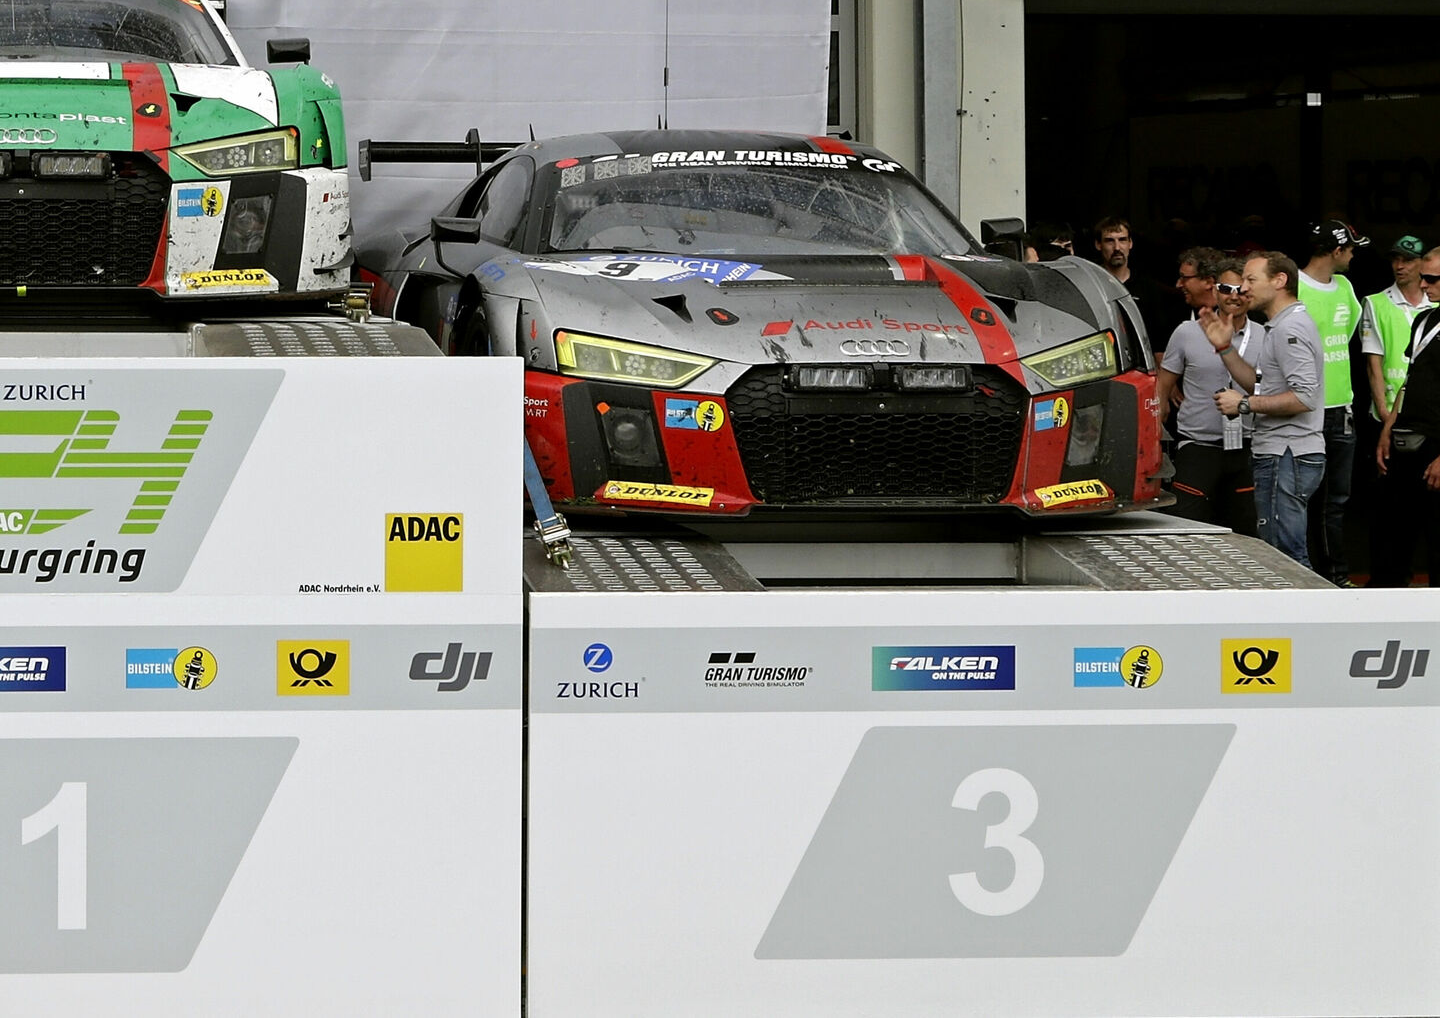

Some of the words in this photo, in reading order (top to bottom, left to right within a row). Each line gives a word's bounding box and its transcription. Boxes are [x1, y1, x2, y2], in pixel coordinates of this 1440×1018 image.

[651, 150, 726, 163] GRAN
[734, 150, 849, 165] TURISMO
[178, 198, 201, 207] BILSTEIN
[200, 273, 265, 283] DUNLOP
[803, 319, 874, 331] Audi
[882, 318, 969, 335] Sport
[1325, 334, 1348, 347] GRID
[1323, 349, 1350, 363] ARSH
[4, 384, 86, 401] ZURICH
[524, 396, 549, 407] Sport
[624, 486, 709, 500] DUNLOP
[1053, 484, 1103, 498] DUNLO
[388, 516, 461, 542] ADAC
[298, 584, 322, 593] ADAC
[323, 584, 364, 593] Nordrhein
[366, 584, 381, 593] e.V.
[127, 663, 172, 675] BILSTEIN
[890, 656, 999, 671] FALKEN
[1075, 662, 1119, 674] BILSTEIN
[16, 674, 46, 682] PULSE
[705, 667, 743, 681] GRAN
[746, 667, 808, 681] TURISMO
[932, 672, 946, 680] ON
[948, 672, 965, 680] THE
[967, 672, 996, 680] PULSE
[557, 682, 639, 698] ZURICH
[948, 767, 1045, 917] 3
[21, 781, 88, 931] 1
